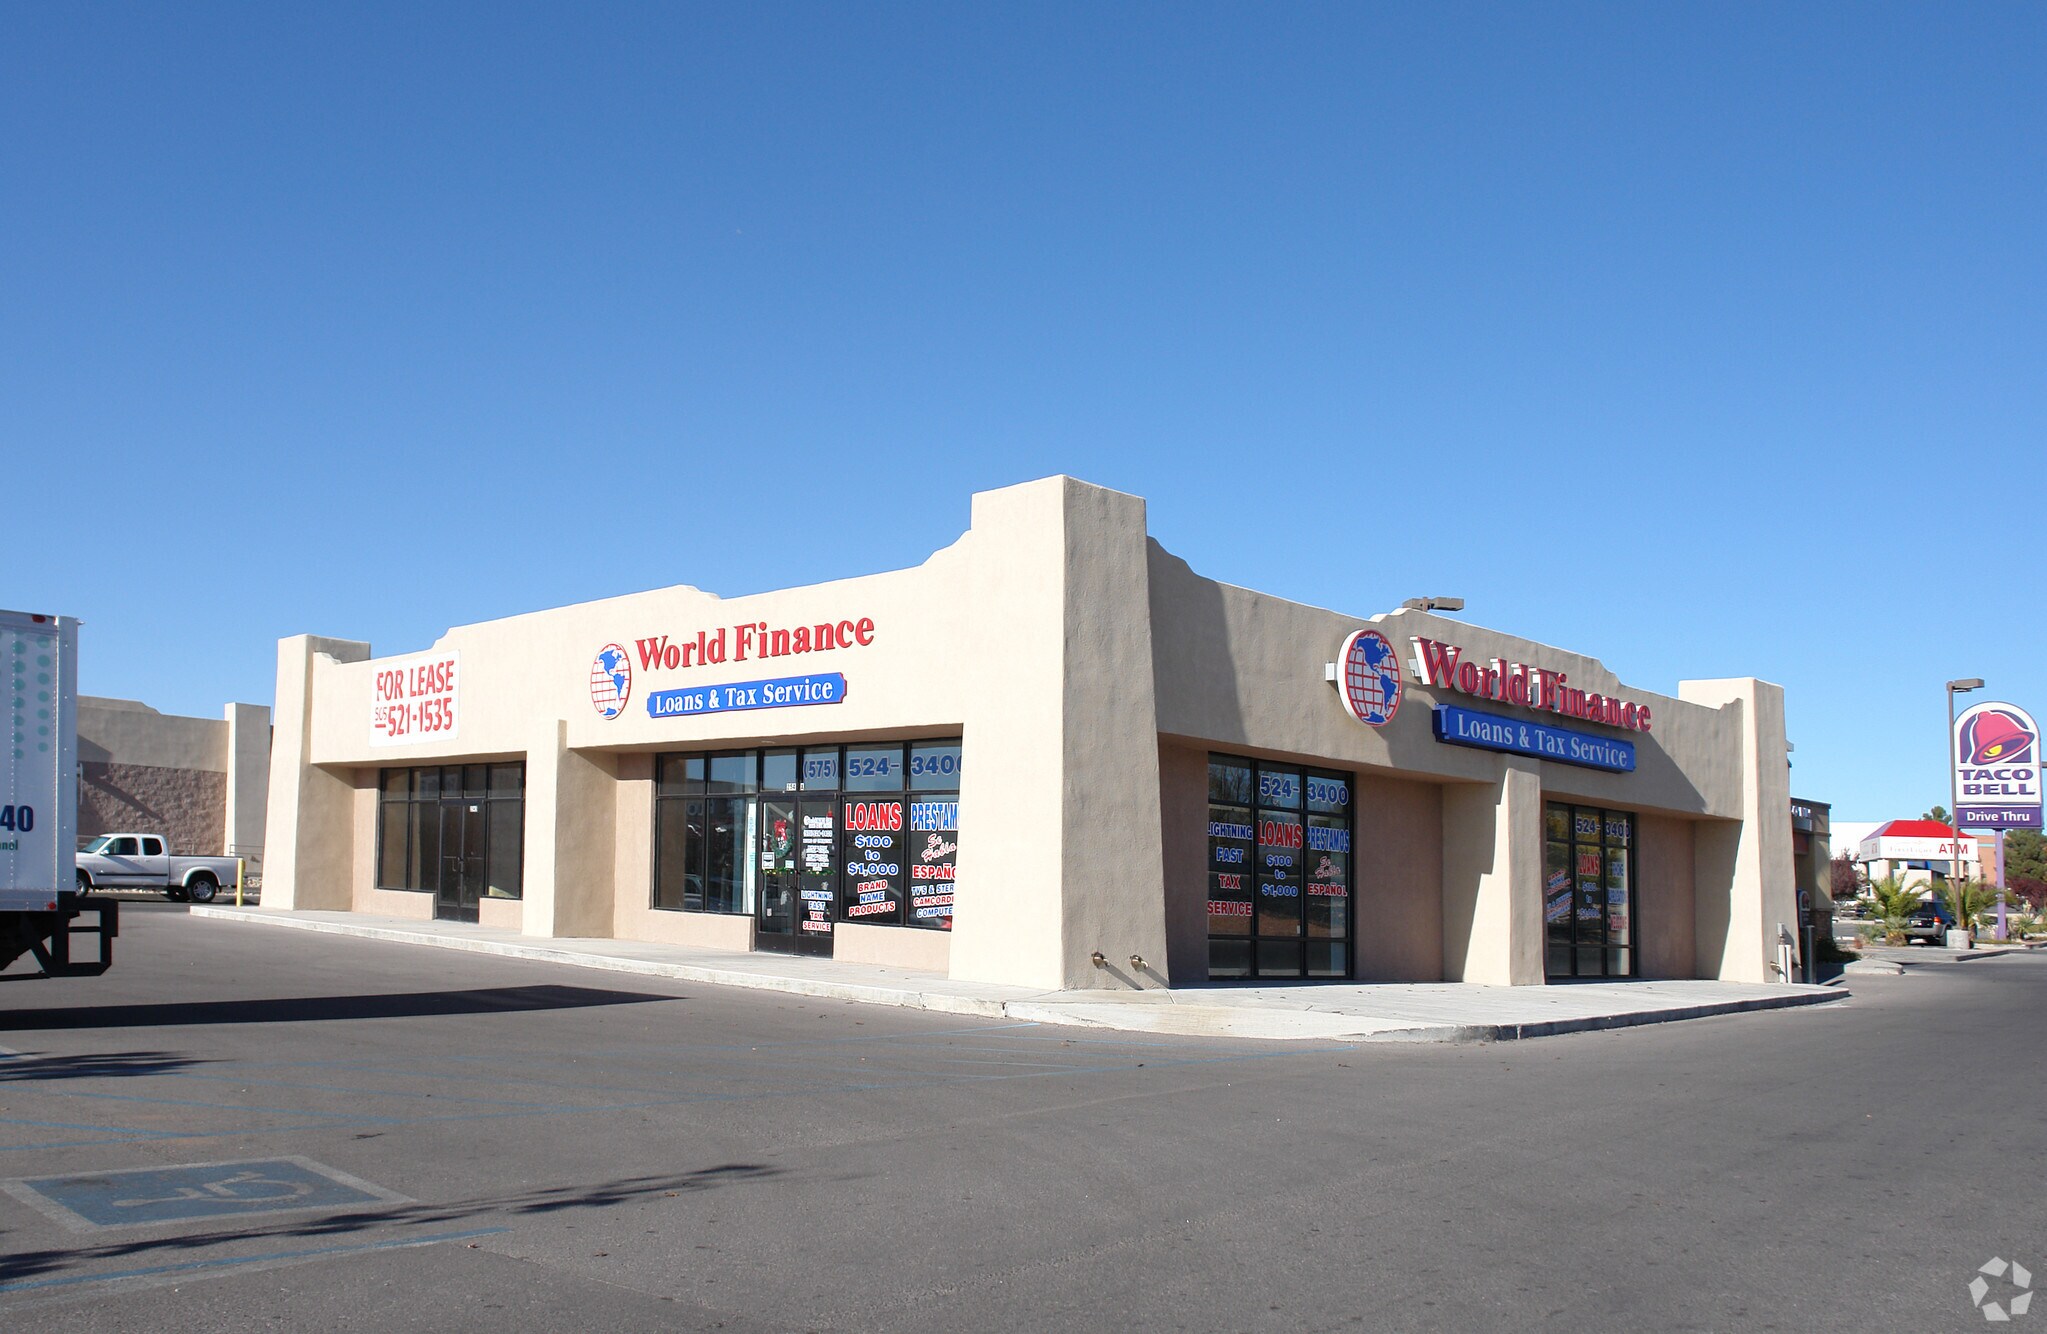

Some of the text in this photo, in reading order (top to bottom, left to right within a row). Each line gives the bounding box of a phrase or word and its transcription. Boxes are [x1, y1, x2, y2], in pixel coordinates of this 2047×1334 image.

[634, 617, 875, 672] World Finance
[376, 660, 455, 702] FOR LEASE
[1417, 636, 1652, 733] World Finance
[655, 678, 833, 714] Loans & Tax Service
[388, 697, 453, 737] 521-1535
[1457, 713, 1628, 767] Loans & Tax Service
[803, 759, 837, 779] (575)
[848, 755, 901, 777] 524-
[1958, 768, 2034, 781] TACO
[1260, 775, 1349, 805] 524- 3400
[1963, 783, 2036, 796] BELL
[846, 802, 902, 831] LOANS
[1966, 810, 2030, 823] Drive Thru
[855, 834, 892, 848] $100
[1258, 820, 1303, 849] LOANS
[865, 850, 880, 861] to
[1216, 846, 1244, 863] FAST
[1938, 843, 1969, 855] ATM
[1266, 854, 1293, 867] $100
[848, 862, 898, 877] $1,000
[1274, 869, 1286, 880] to
[857, 880, 888, 893] BRAND
[1218, 874, 1241, 890] TAX
[801, 890, 833, 901] LIGHTNING
[859, 891, 886, 904] NAME
[1262, 883, 1298, 898] $1,000
[808, 901, 826, 910] FAST
[848, 901, 896, 917] PRODUCTS
[1208, 901, 1252, 917] SERVICE
[810, 911, 824, 921] TAX
[803, 921, 832, 932] SERVICE
